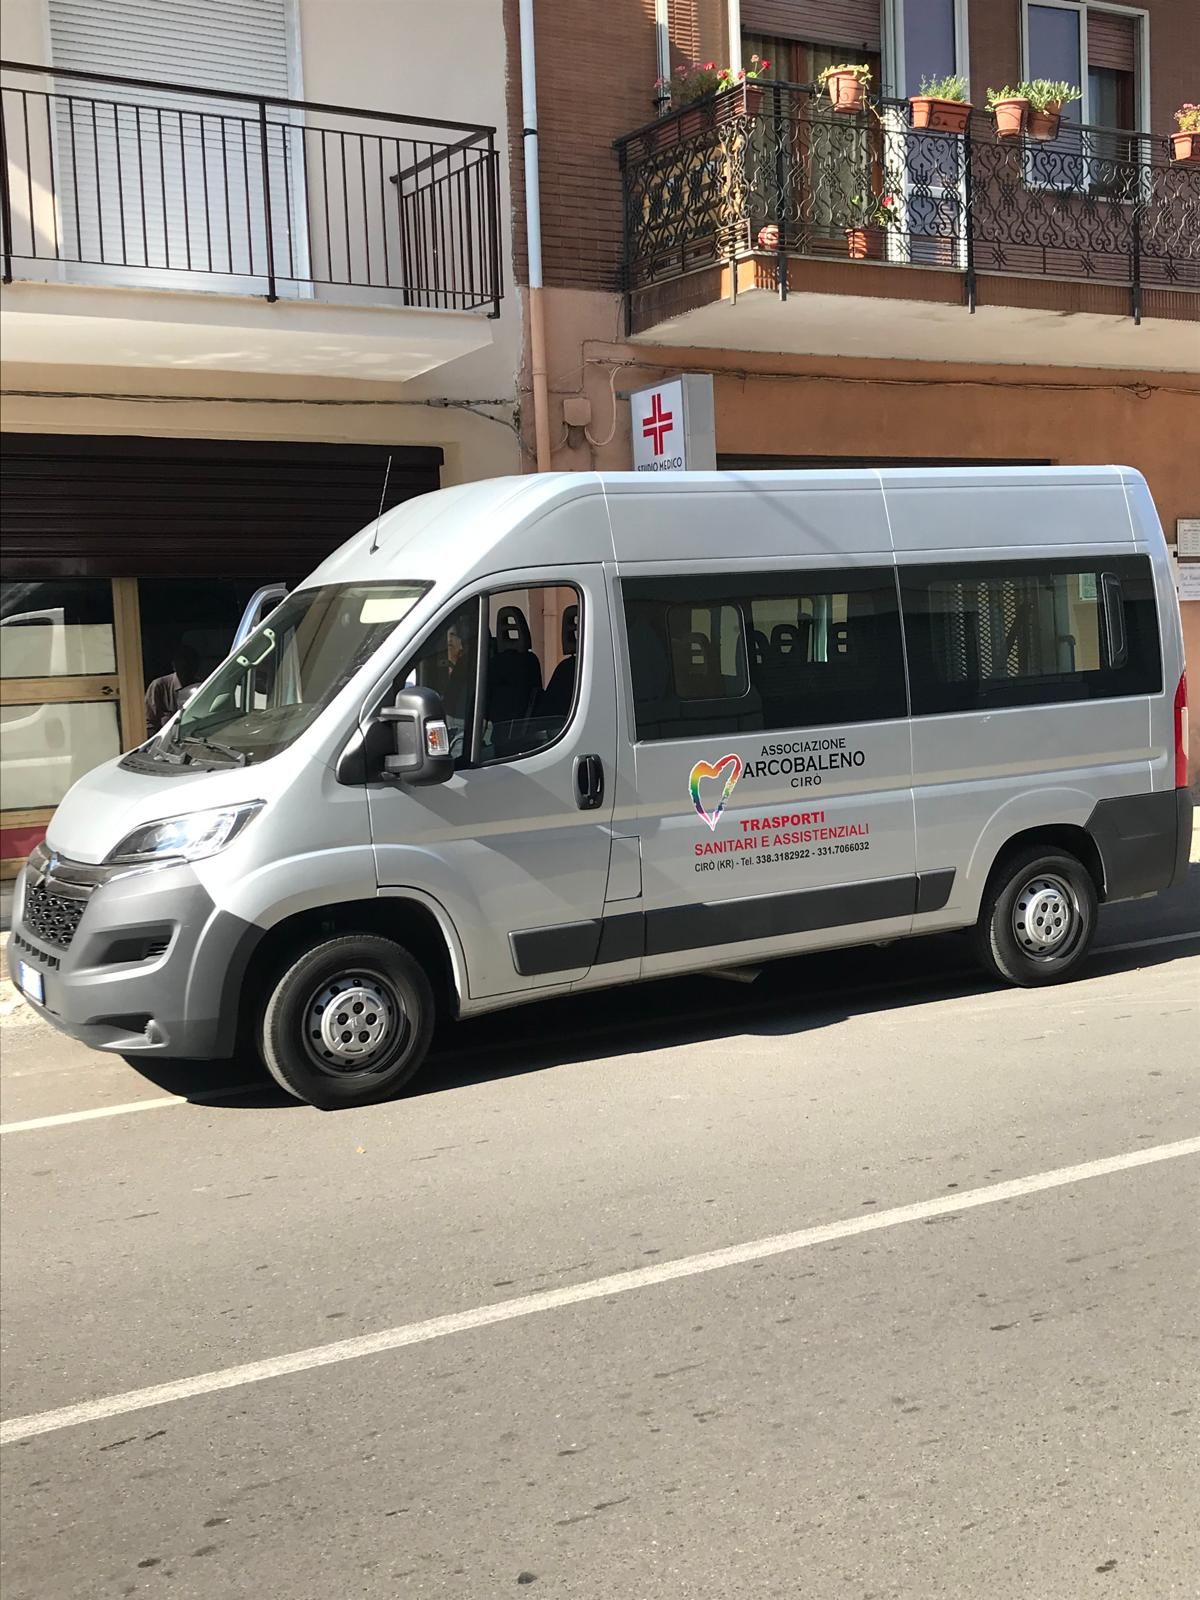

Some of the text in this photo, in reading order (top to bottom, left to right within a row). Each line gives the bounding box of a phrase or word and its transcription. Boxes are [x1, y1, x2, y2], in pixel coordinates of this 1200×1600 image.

[659, 456, 683, 471] MEDICO
[760, 738, 846, 757] ASSOCIAZIONE
[743, 750, 865, 779] ARCOBALENO
[790, 775, 822, 788] CIRÒ
[740, 811, 825, 832] TRASPORTI
[694, 823, 870, 856] SANITARI E ASSISTENZIALI
[694, 859, 715, 872] CIRÒ
[717, 857, 734, 872] (KR)
[740, 855, 755, 867] Tel.
[755, 849, 810, 864] 338.3182922
[817, 841, 870, 856] 331.7066032
